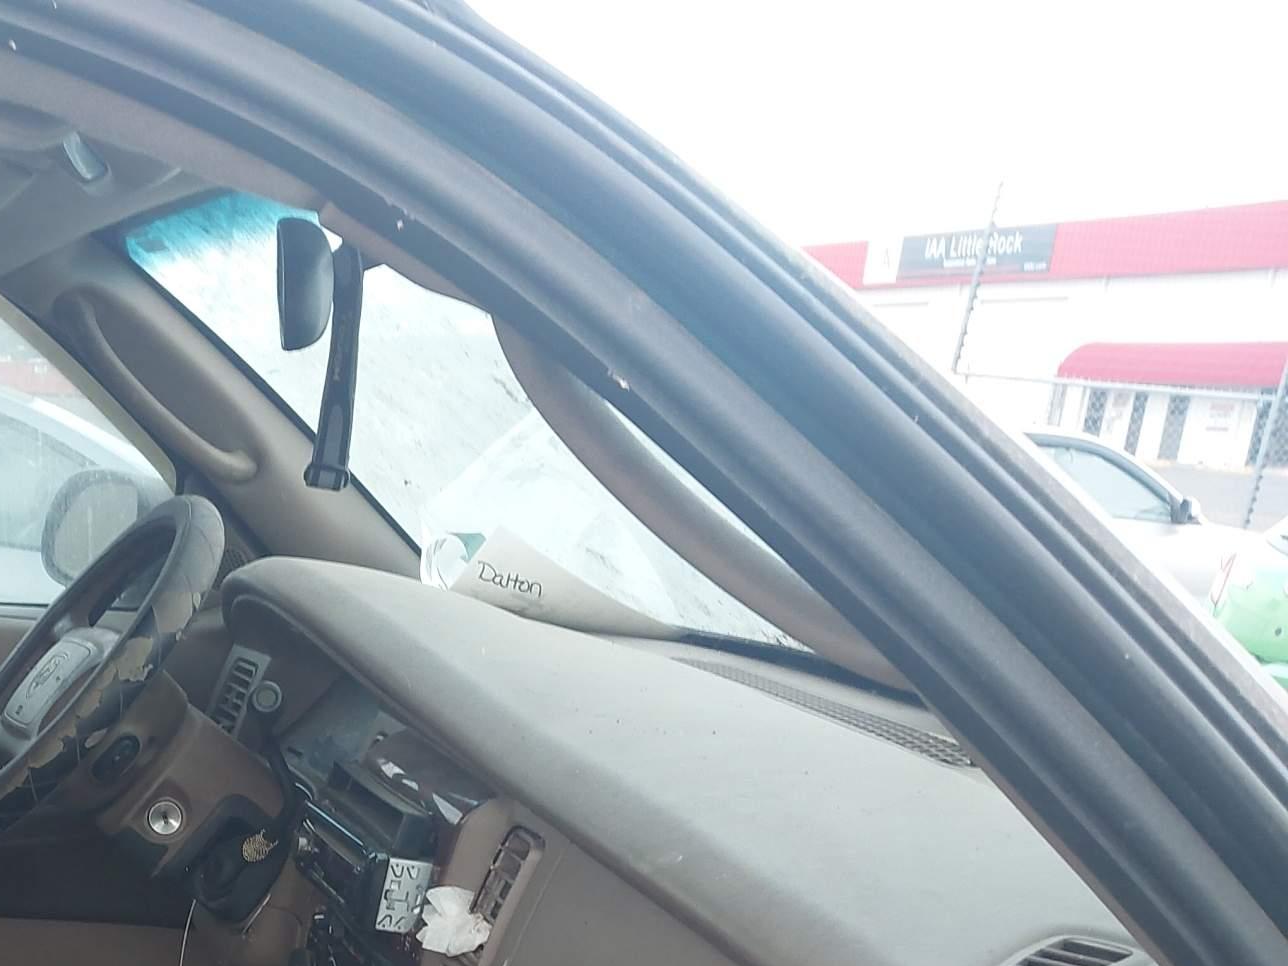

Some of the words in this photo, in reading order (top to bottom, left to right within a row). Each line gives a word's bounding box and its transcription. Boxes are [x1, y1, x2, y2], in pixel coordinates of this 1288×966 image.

[924, 237, 946, 259] IAA
[950, 234, 983, 257] Little
[987, 231, 1023, 255] Rock
[478, 560, 543, 598] Dalton
